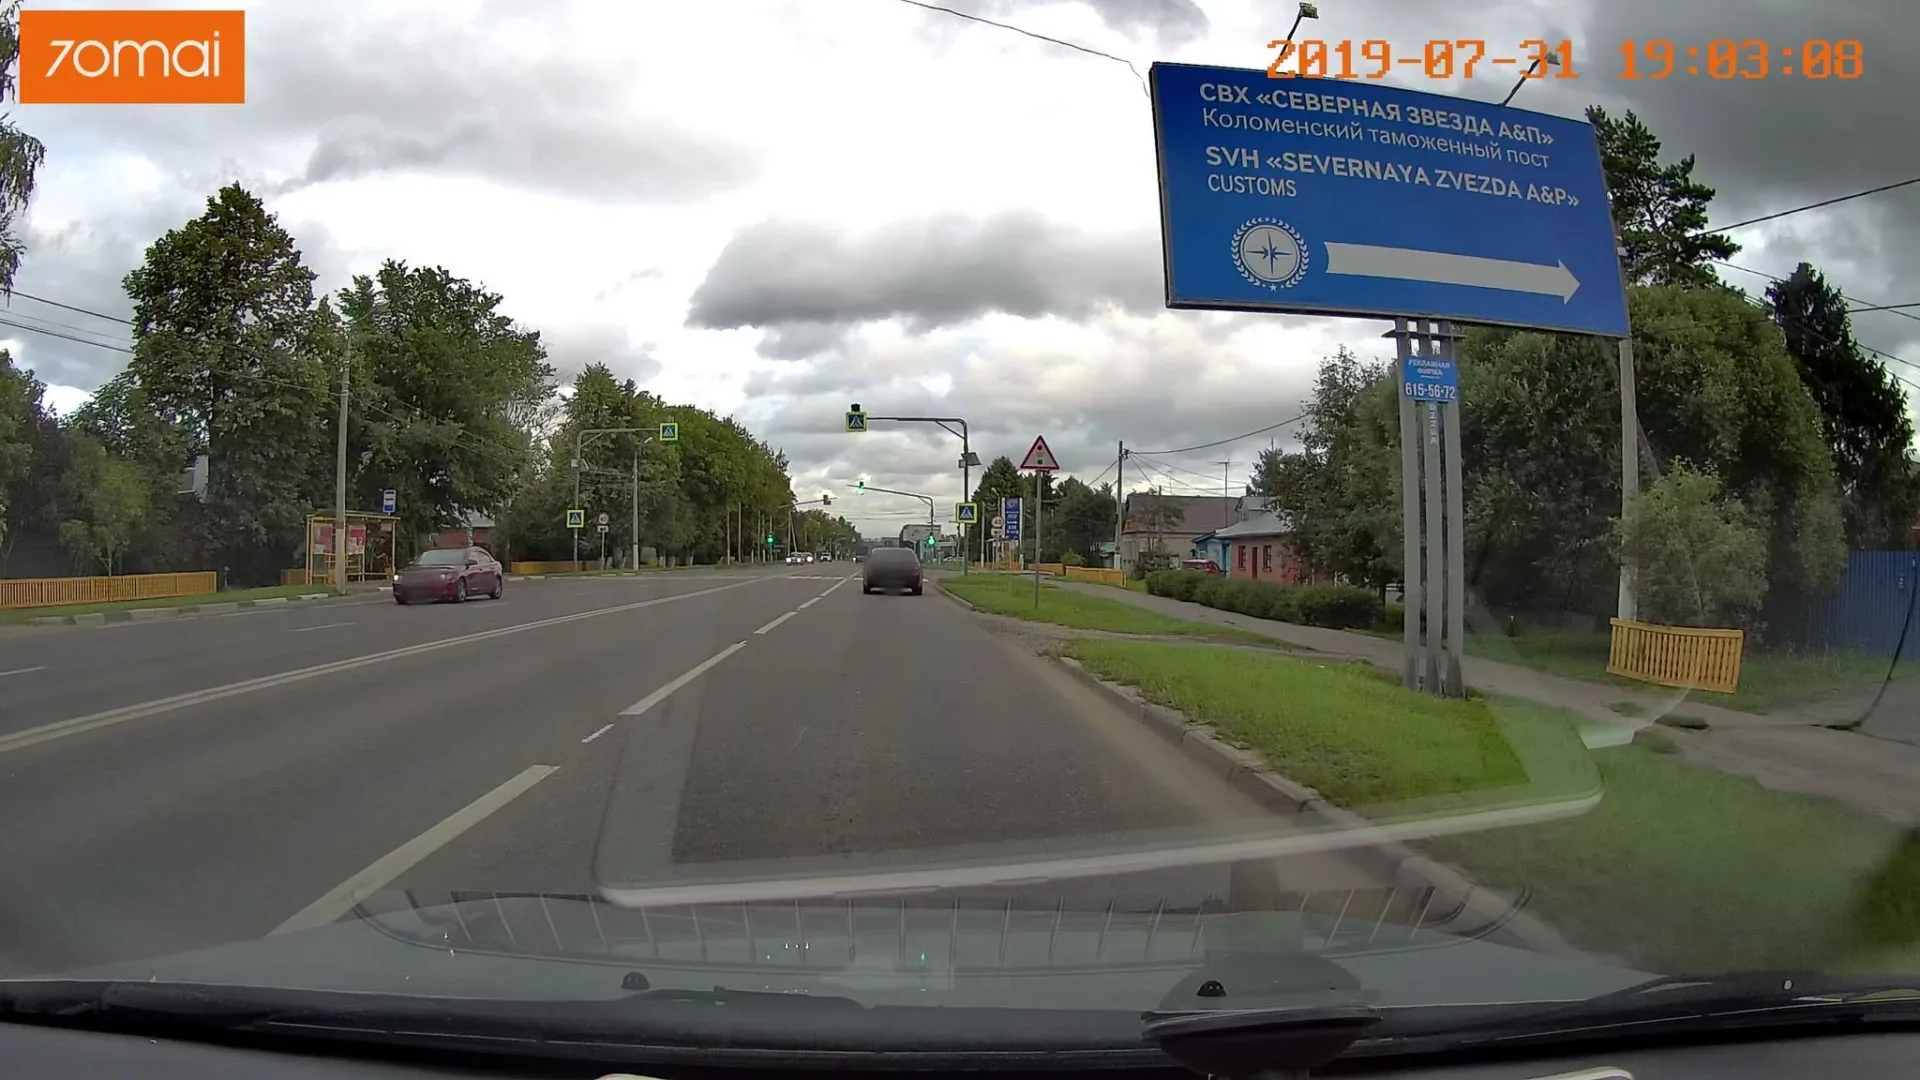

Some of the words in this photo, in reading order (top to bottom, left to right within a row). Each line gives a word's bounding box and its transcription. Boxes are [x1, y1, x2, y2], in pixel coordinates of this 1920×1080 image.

[1199, 82, 1252, 105] СВХ
[1256, 89, 1402, 122] «СЕВЕРНАЯ
[1406, 105, 1495, 137] ЗВЕЗДА
[1499, 121, 1555, 145] А&П»
[1202, 107, 1364, 142] Коломенский
[1367, 127, 1502, 161] таможенный
[1506, 149, 1550, 169] пост
[1205, 145, 1260, 169] SVH
[1265, 151, 1432, 187] «SEVERNAYA
[1434, 169, 1523, 200] ZVEZDA
[1526, 183, 1580, 207] A&P»
[1207, 173, 1298, 197] CUSTOMS
